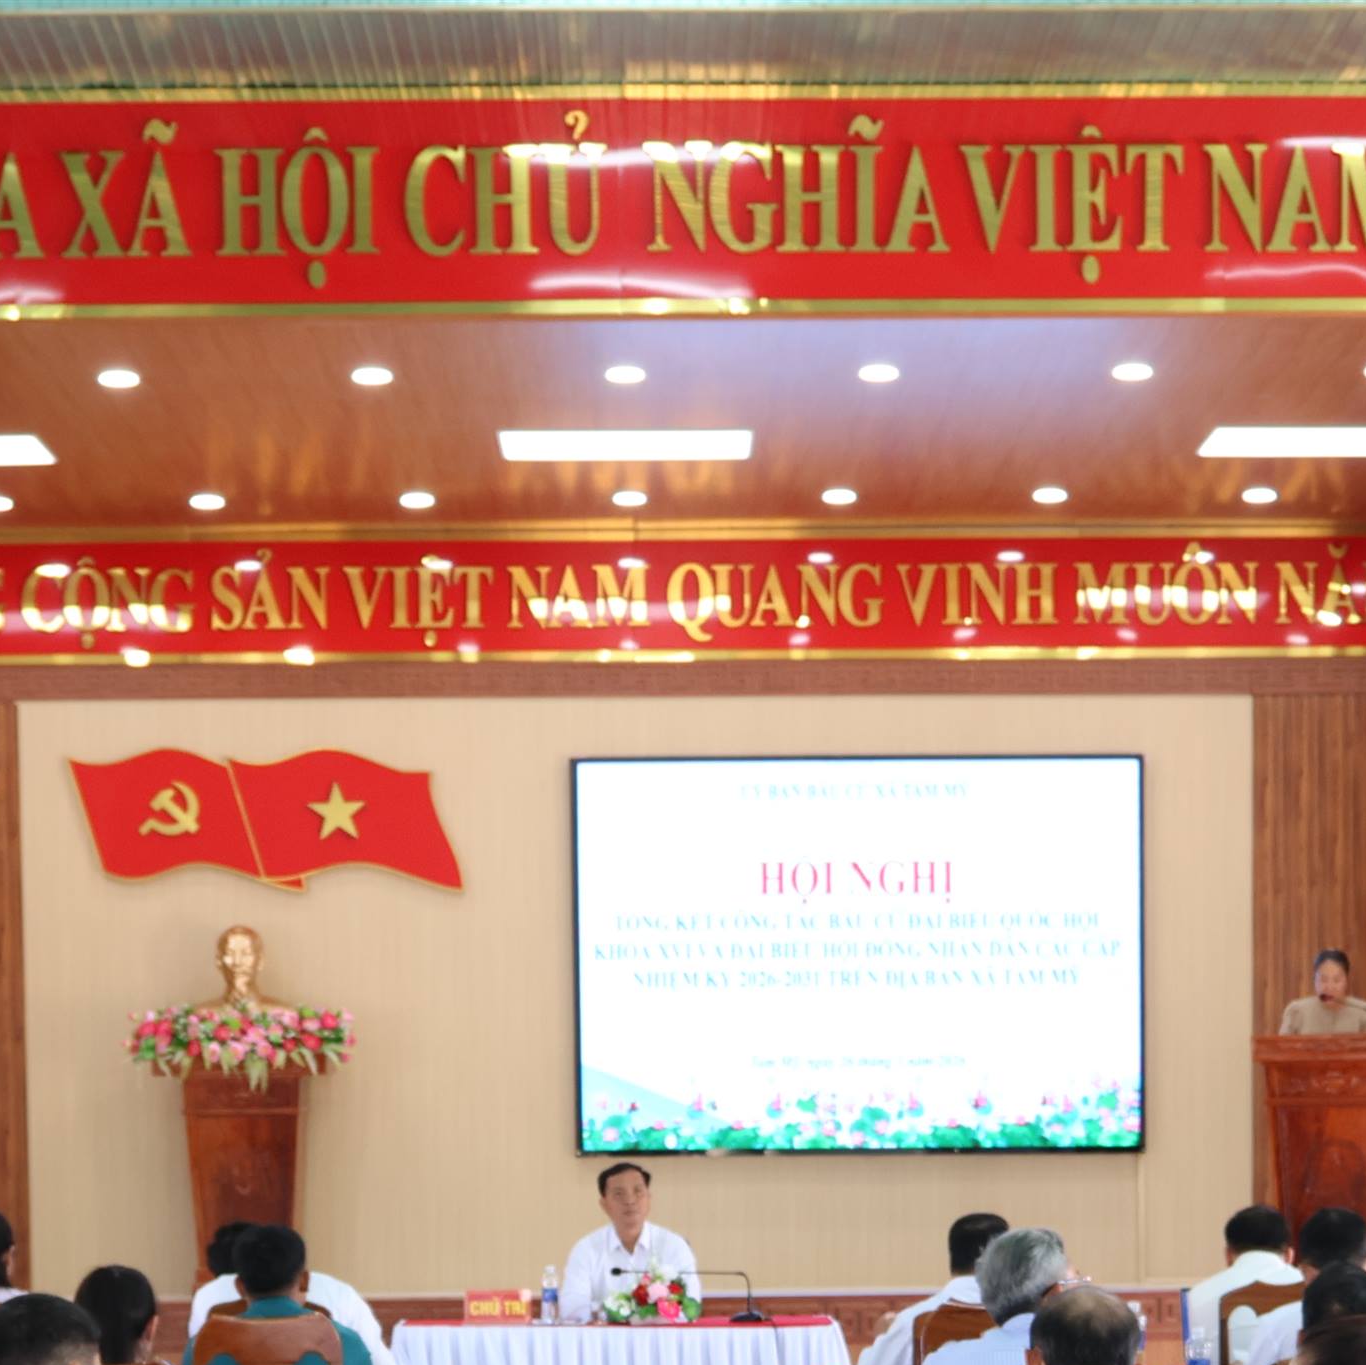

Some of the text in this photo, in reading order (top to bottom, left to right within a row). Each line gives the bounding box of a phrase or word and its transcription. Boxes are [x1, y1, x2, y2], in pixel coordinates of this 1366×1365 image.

[60, 118, 194, 258] XÃ
[214, 125, 380, 289] HỘI
[403, 109, 604, 256] CHỦ
[642, 113, 950, 255] NGHĨA
[959, 124, 1184, 284] VIỆT
[20, 556, 194, 649] CỘNG
[210, 548, 331, 631] SẢN
[342, 554, 494, 648] VIỆT
[507, 564, 652, 629] NAM
[666, 562, 885, 643] QUANG
[896, 562, 1059, 627] VINH
[1073, 541, 1259, 626] MUÔN
[760, 859, 953, 904] HỘI NGHỊ
